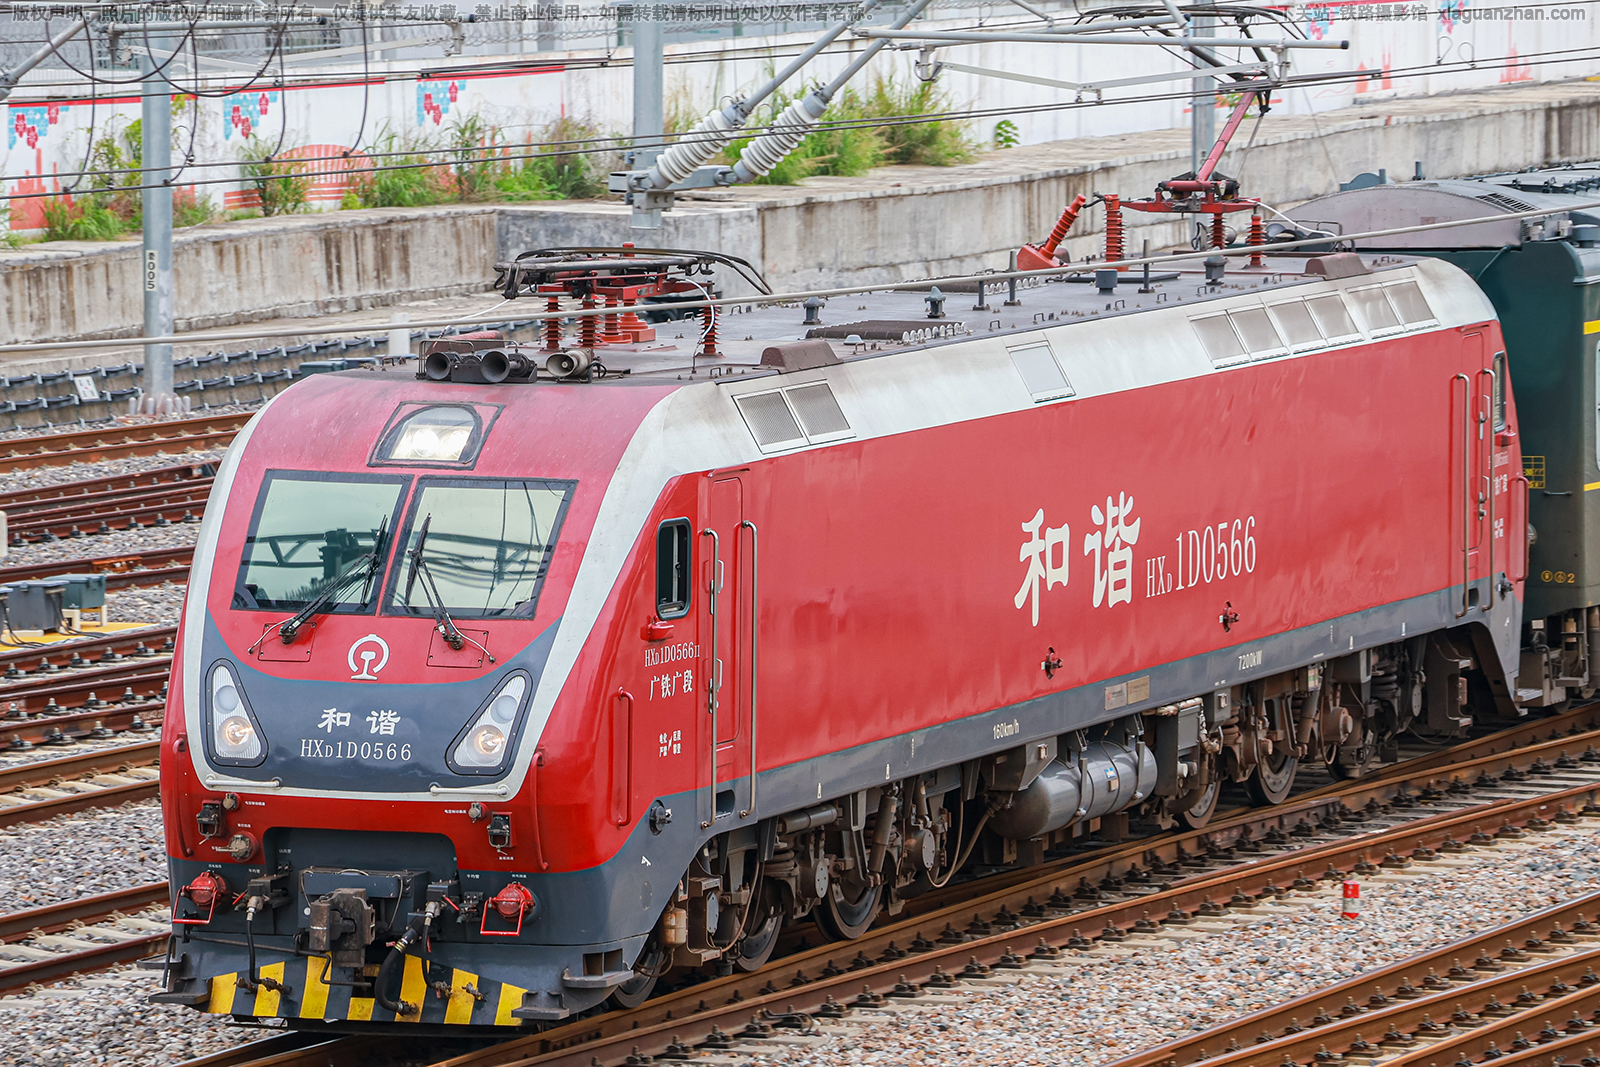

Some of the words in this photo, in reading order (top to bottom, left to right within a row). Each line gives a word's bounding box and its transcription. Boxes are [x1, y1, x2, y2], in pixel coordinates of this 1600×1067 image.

[1013, 490, 1141, 627] 和谐
[649, 669, 693, 702] 广铁广段
[316, 706, 402, 736] 和谐
[299, 738, 413, 762] HXD1D0566
